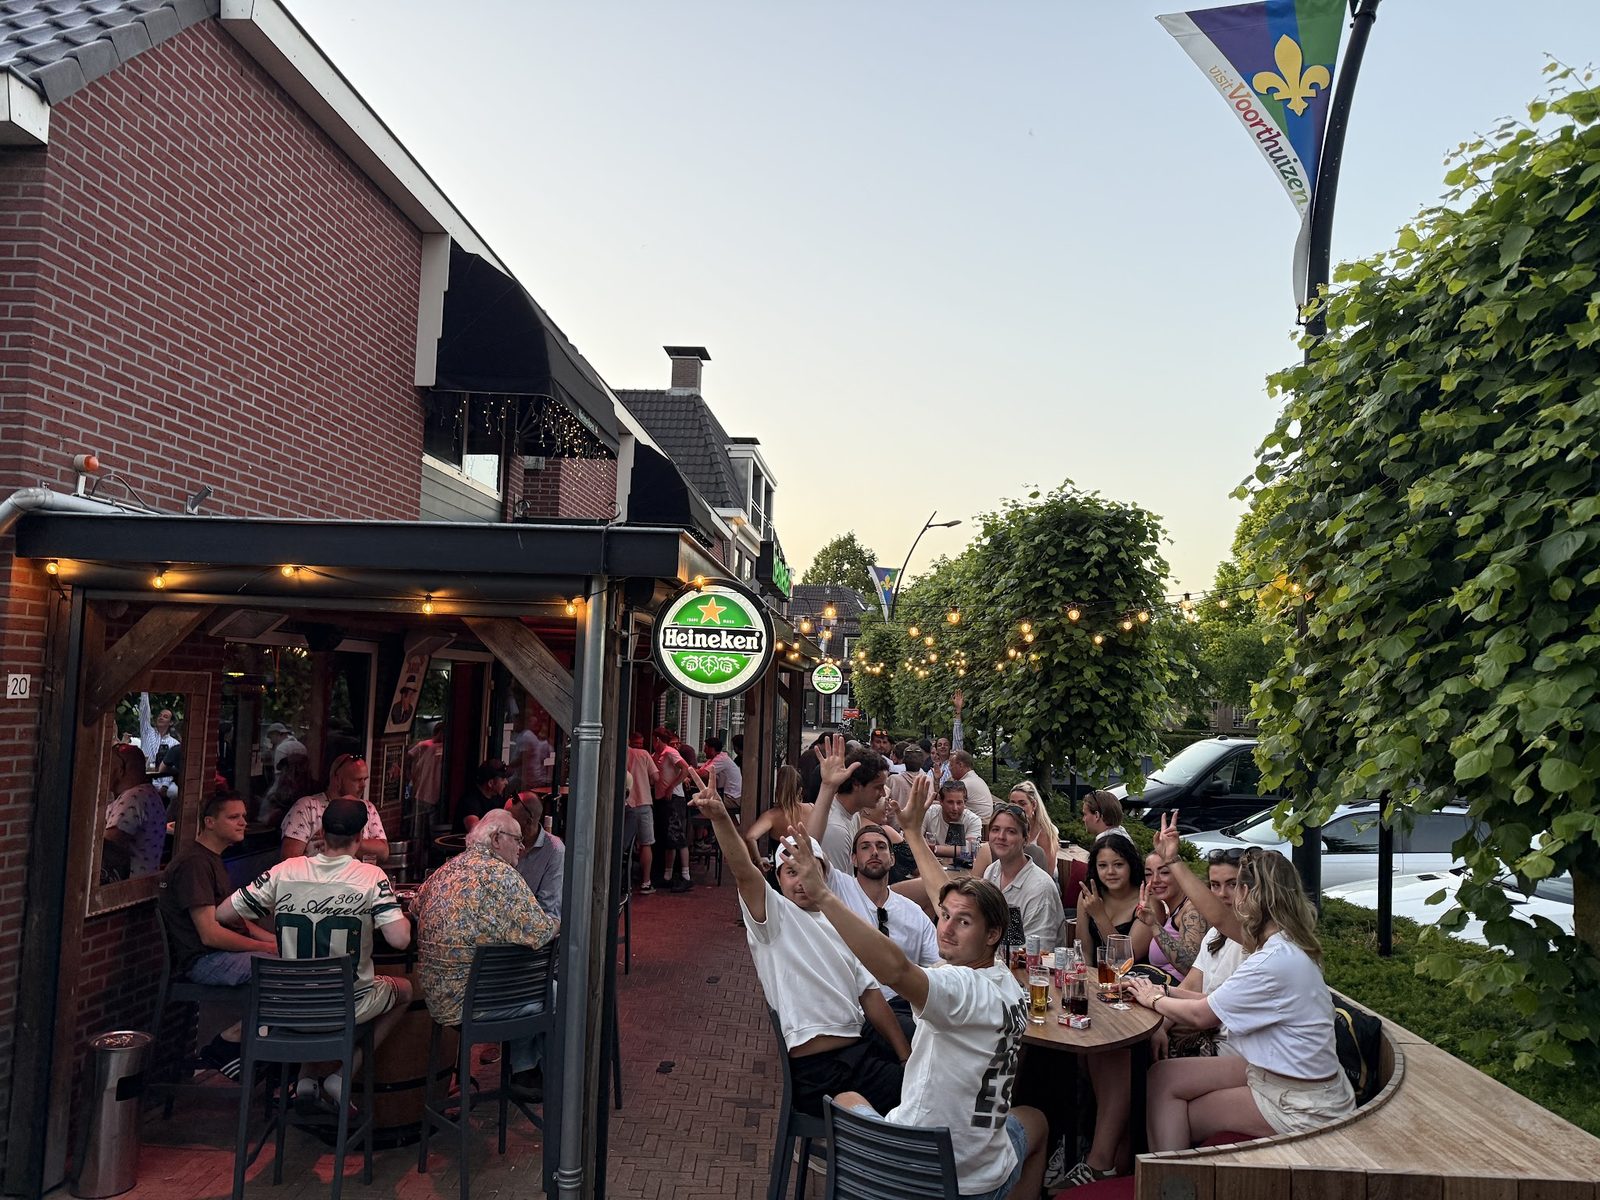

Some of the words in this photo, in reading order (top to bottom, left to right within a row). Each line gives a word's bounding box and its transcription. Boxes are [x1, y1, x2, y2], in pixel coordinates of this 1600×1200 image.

[1208, 64, 1233, 91] visit
[664, 628, 760, 650] Heineken
[11, 677, 28, 695] 20
[334, 893, 363, 904] 369
